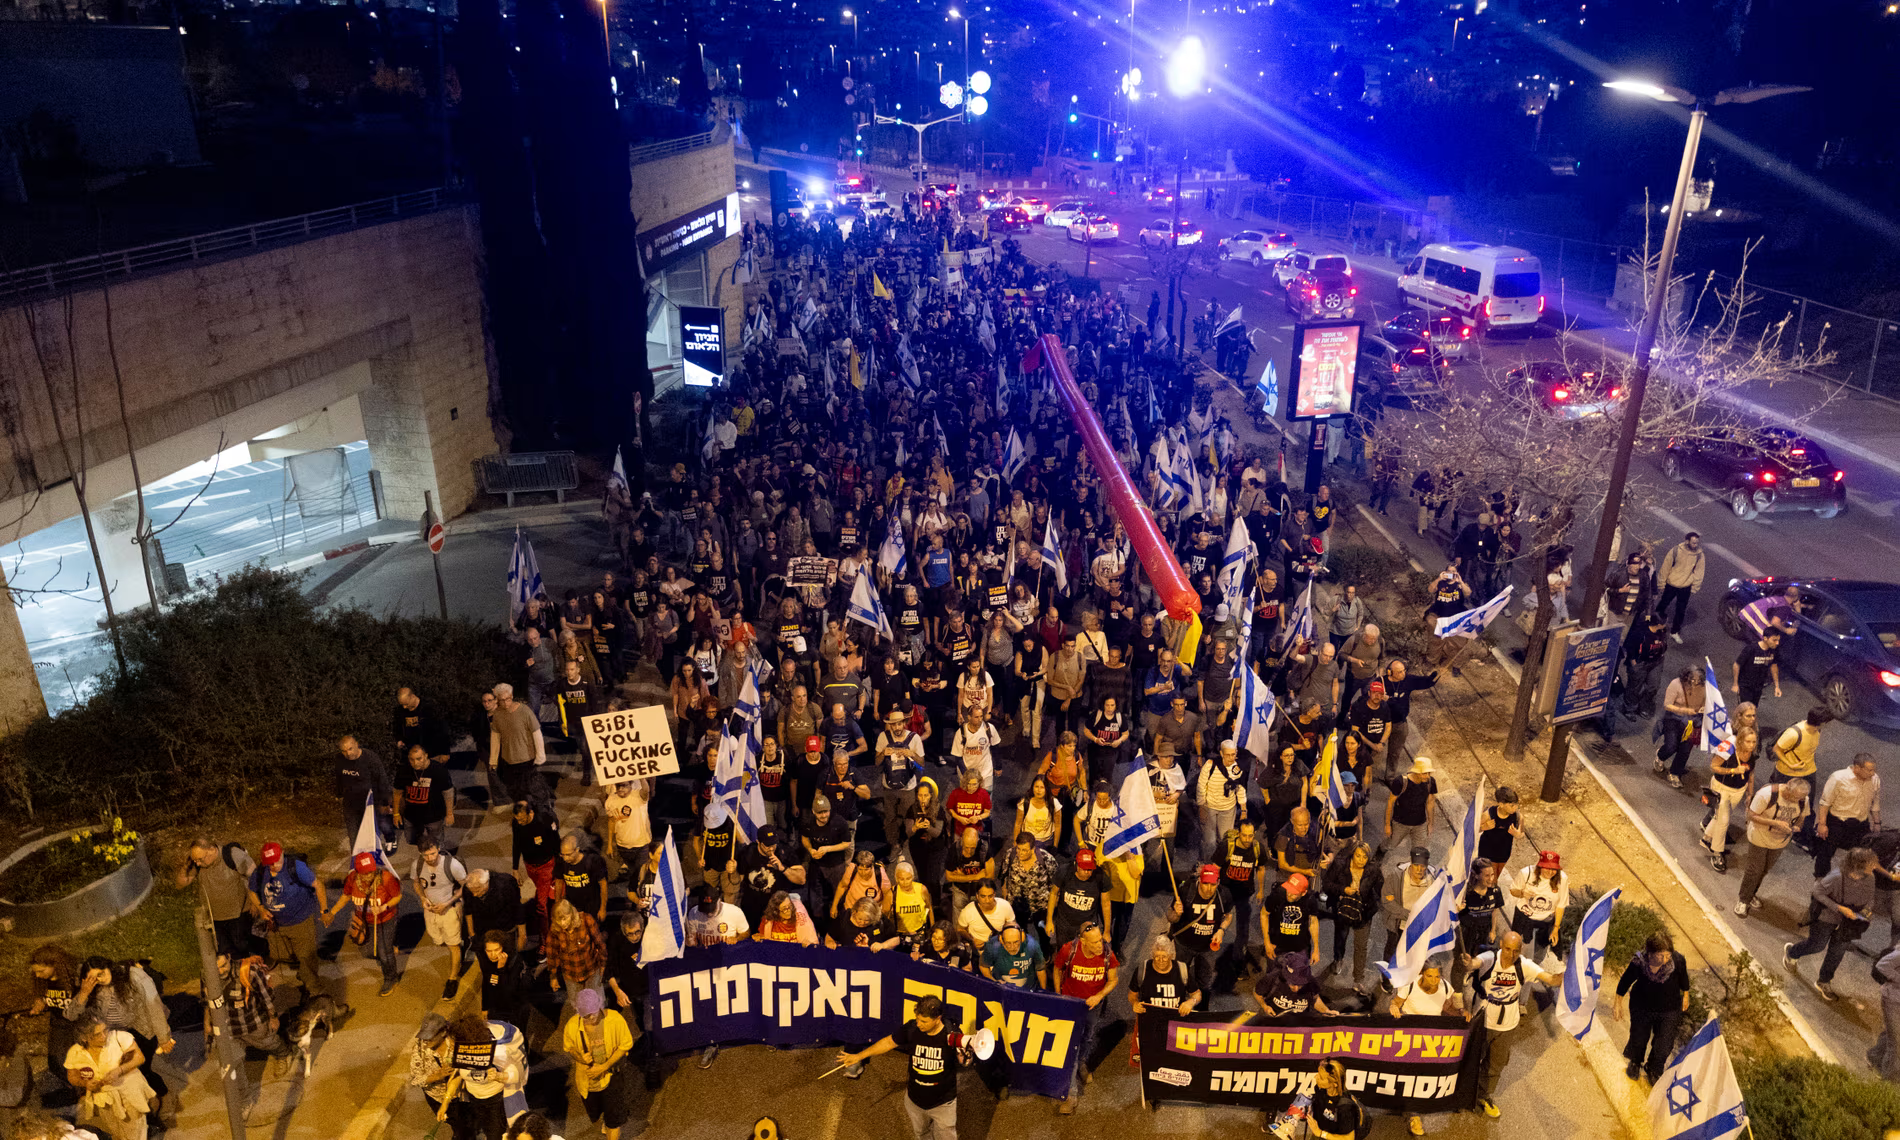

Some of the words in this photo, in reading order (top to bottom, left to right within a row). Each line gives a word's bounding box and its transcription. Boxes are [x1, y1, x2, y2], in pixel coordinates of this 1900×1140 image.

[685, 342, 720, 351] הלאום
[694, 333, 719, 342] חניון
[598, 731, 641, 749] YOU
[594, 742, 672, 766] FUCKING
[342, 769, 360, 777] RVCA
[603, 760, 661, 779] LOSER
[659, 963, 882, 1028] האקדמיה
[1156, 984, 1175, 997] מרי
[1175, 1026, 1305, 1055] החטופים
[1310, 1031, 1355, 1055] את
[1359, 1030, 1464, 1058] מצילים
[456, 1054, 491, 1062] מסרבים
[915, 1044, 942, 1059] בוחרים
[456, 1059, 490, 1067] למלחמה
[912, 1055, 944, 1070] בחטופים
[1209, 1067, 1319, 1095] מלחמה
[1345, 1070, 1458, 1099] מסרבים
